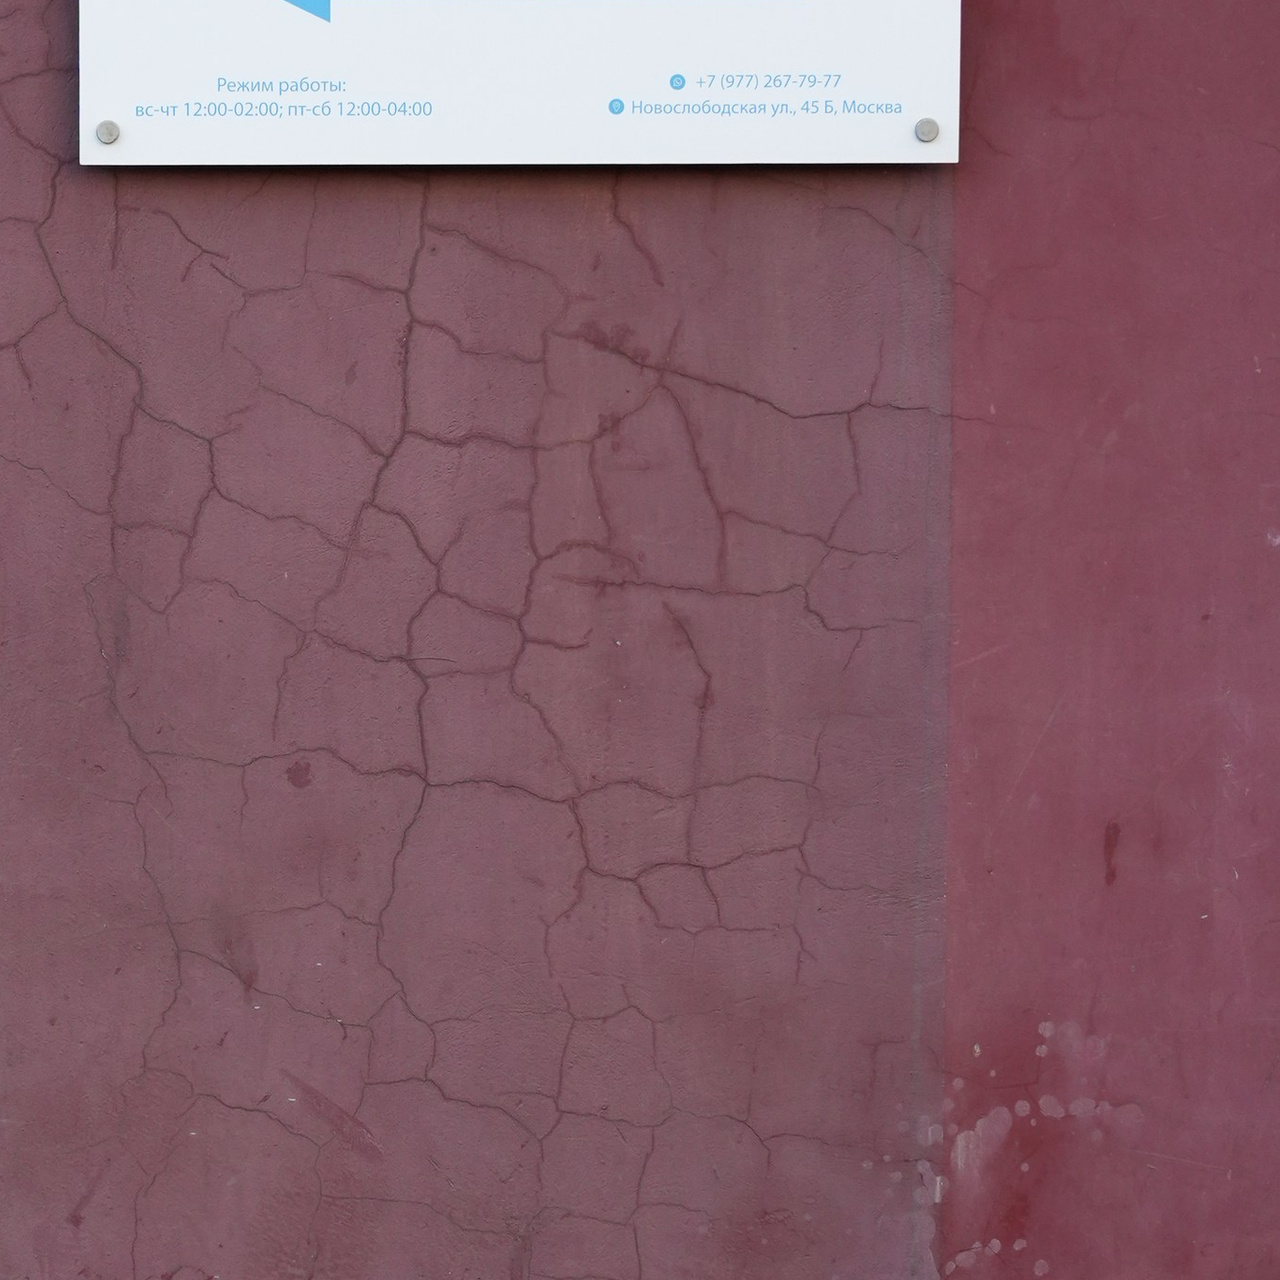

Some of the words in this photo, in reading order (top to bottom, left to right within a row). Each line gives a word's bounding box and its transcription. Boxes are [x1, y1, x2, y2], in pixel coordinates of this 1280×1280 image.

[216, 77, 275, 93] Режим
[278, 76, 346, 96] работы:
[695, 74, 716, 88] +7
[720, 73, 759, 91] (977)
[763, 74, 842, 88] 267-79-77
[135, 104, 178, 117] вс-чт
[183, 101, 283, 119] 12:00-02:00;
[288, 101, 331, 117] пт-сб
[337, 101, 433, 116] 12:00-04:00
[631, 99, 766, 117] Новослободская
[770, 102, 797, 118] ул.,
[800, 100, 820, 115] 45
[824, 100, 838, 118] Б,
[842, 100, 903, 115] Москва
